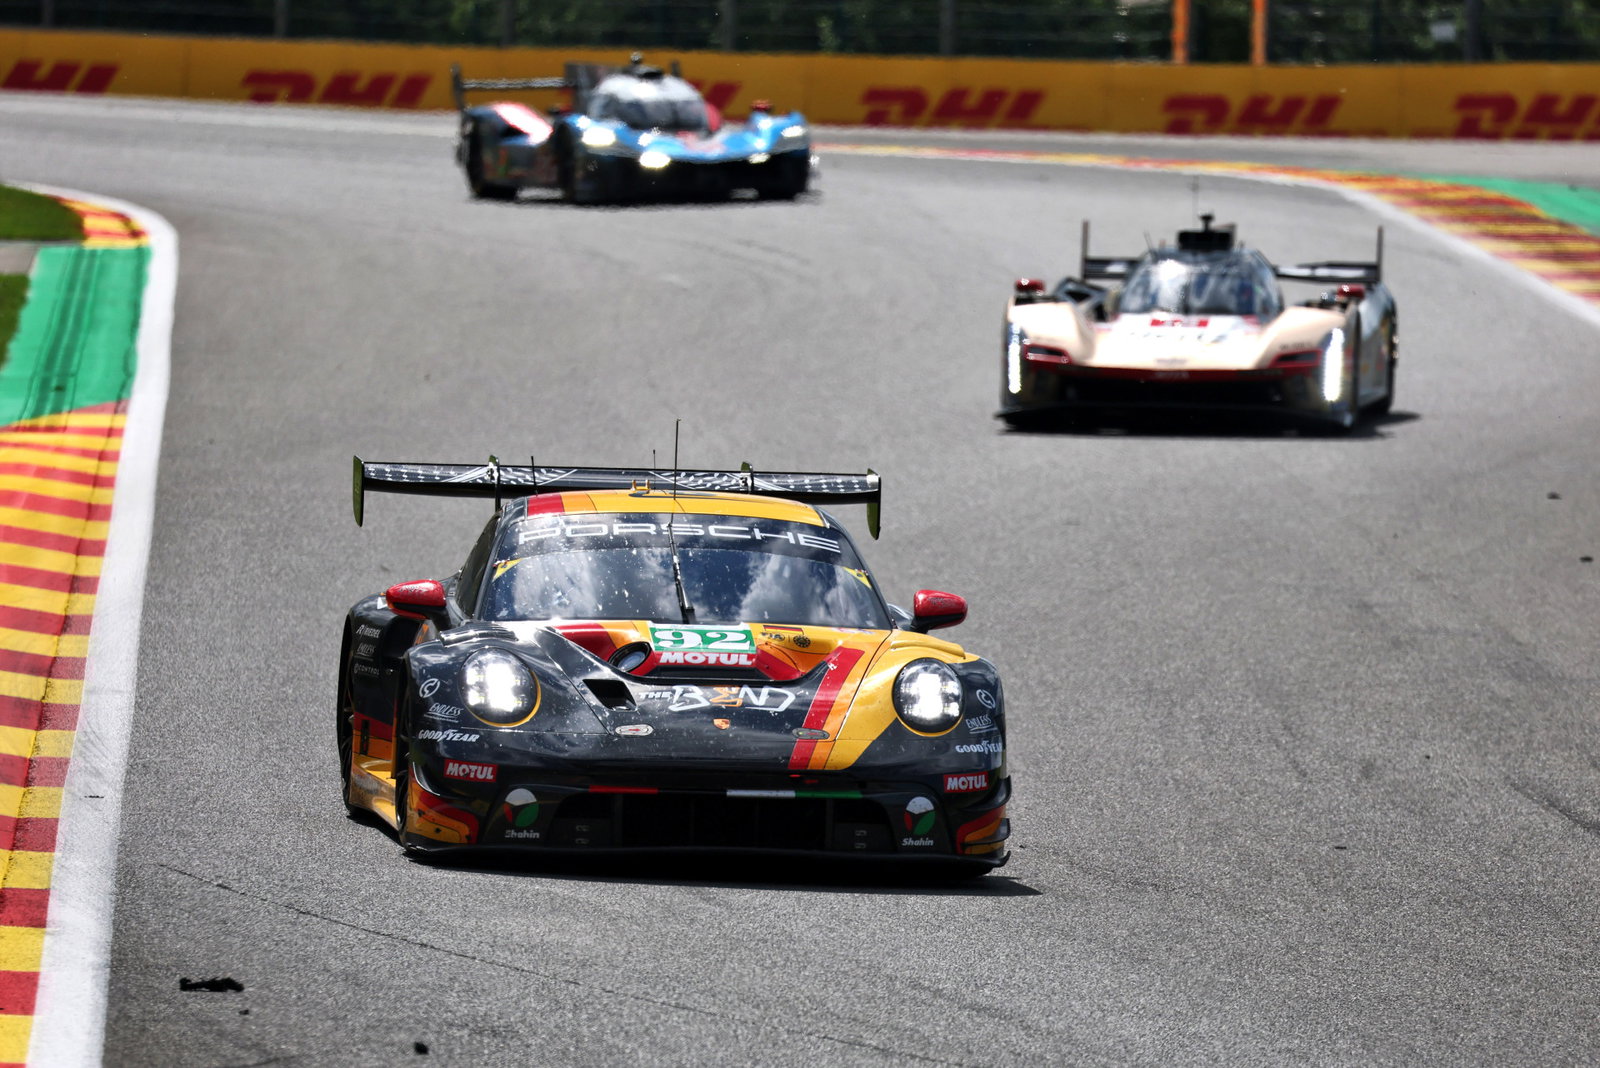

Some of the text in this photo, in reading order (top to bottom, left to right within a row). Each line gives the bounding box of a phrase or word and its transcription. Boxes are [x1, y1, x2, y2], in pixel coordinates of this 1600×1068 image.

[241, 70, 434, 109] DHL
[862, 86, 1046, 129] DHL
[1163, 93, 1345, 136] DHL
[1454, 93, 1600, 140] DH
[518, 523, 841, 553] PORSCHE
[654, 630, 750, 650] 92
[659, 652, 752, 666] MOTUL
[638, 684, 796, 712] THE BEND
[429, 702, 464, 716] ENDLESS
[418, 729, 480, 742] GOODYEAR
[446, 763, 494, 780] MOTUL
[946, 774, 987, 791] MOTUL
[504, 829, 540, 839] Shahin
[902, 837, 934, 847] Shahin
